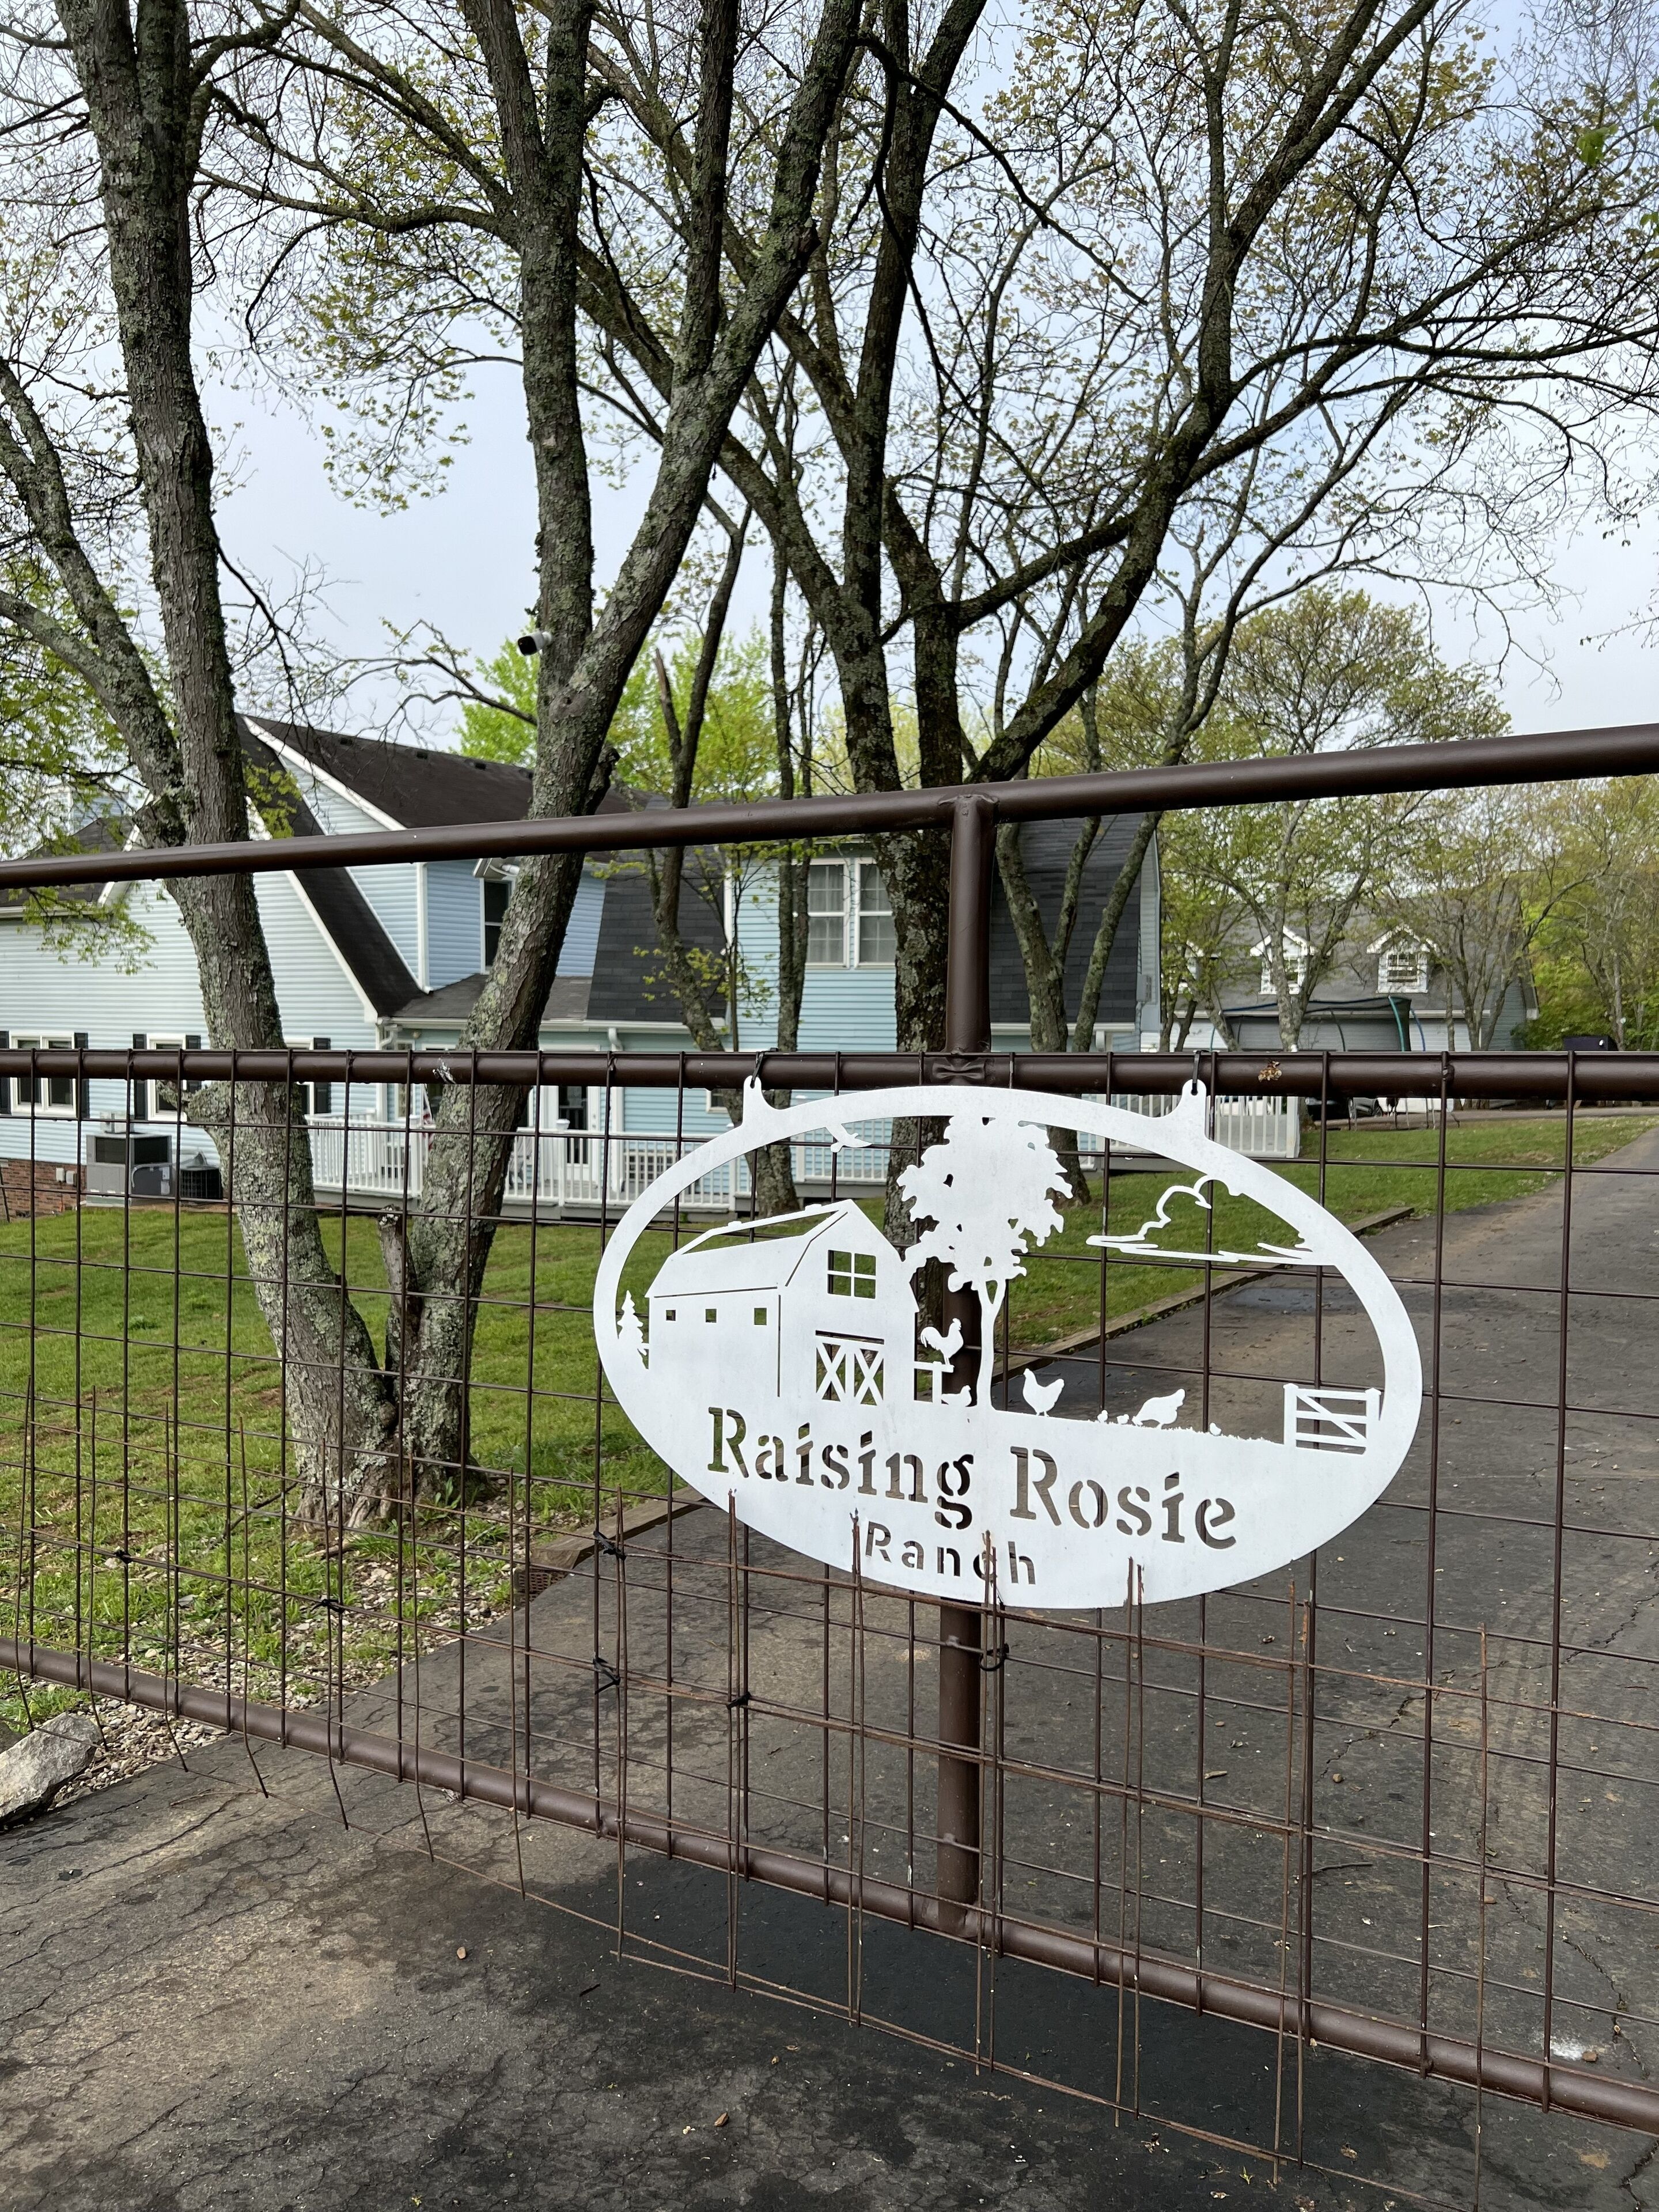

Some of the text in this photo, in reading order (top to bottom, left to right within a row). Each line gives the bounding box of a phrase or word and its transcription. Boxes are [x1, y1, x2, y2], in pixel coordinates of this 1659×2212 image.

[707, 1407, 1237, 1550] Raising Rosie
[865, 1522, 1036, 1585] Ranch
